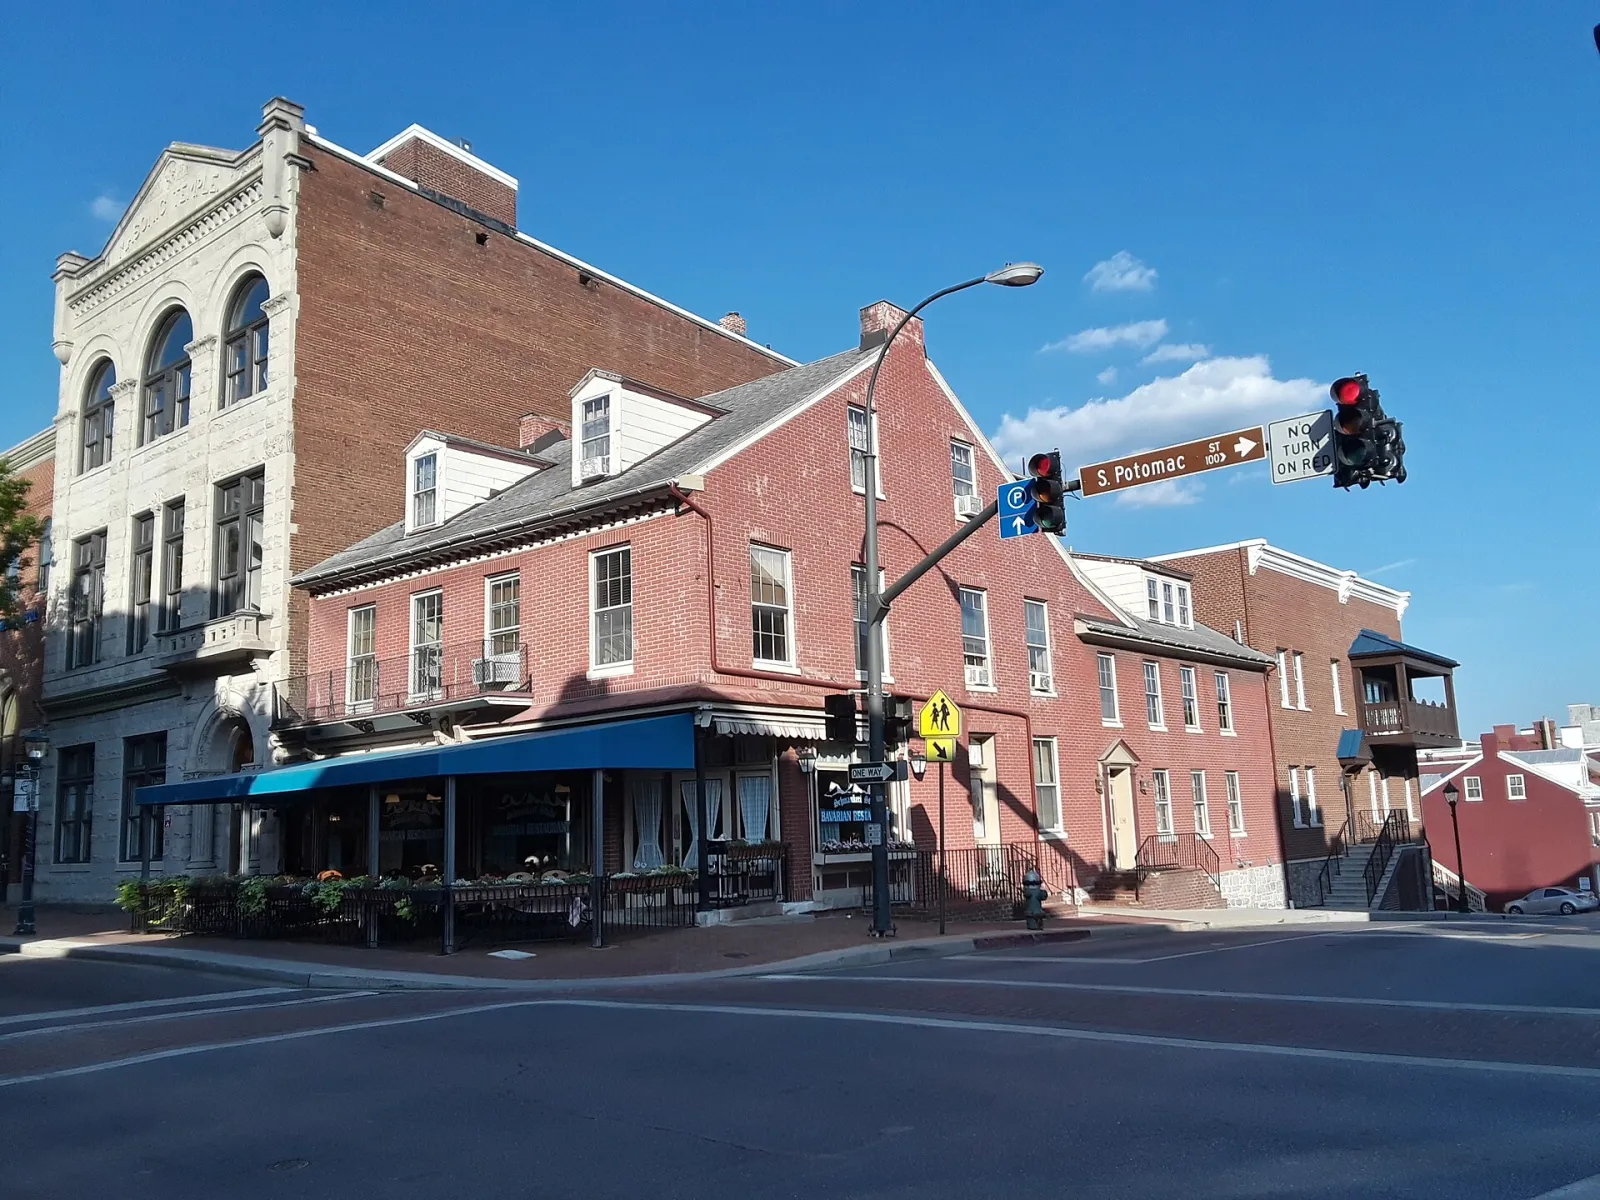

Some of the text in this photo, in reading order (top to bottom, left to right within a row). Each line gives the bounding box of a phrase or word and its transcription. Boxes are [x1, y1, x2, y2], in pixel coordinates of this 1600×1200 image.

[172, 172, 220, 208] TEMPLE
[1288, 423, 1312, 439] NO
[1208, 441, 1222, 453] ST
[1282, 440, 1320, 457] TURN
[1097, 455, 1186, 487] S. Potomac
[1277, 454, 1331, 476] ON RED
[852, 768, 882, 778] ONE WAY
[821, 810, 852, 822] BAVARIAN
